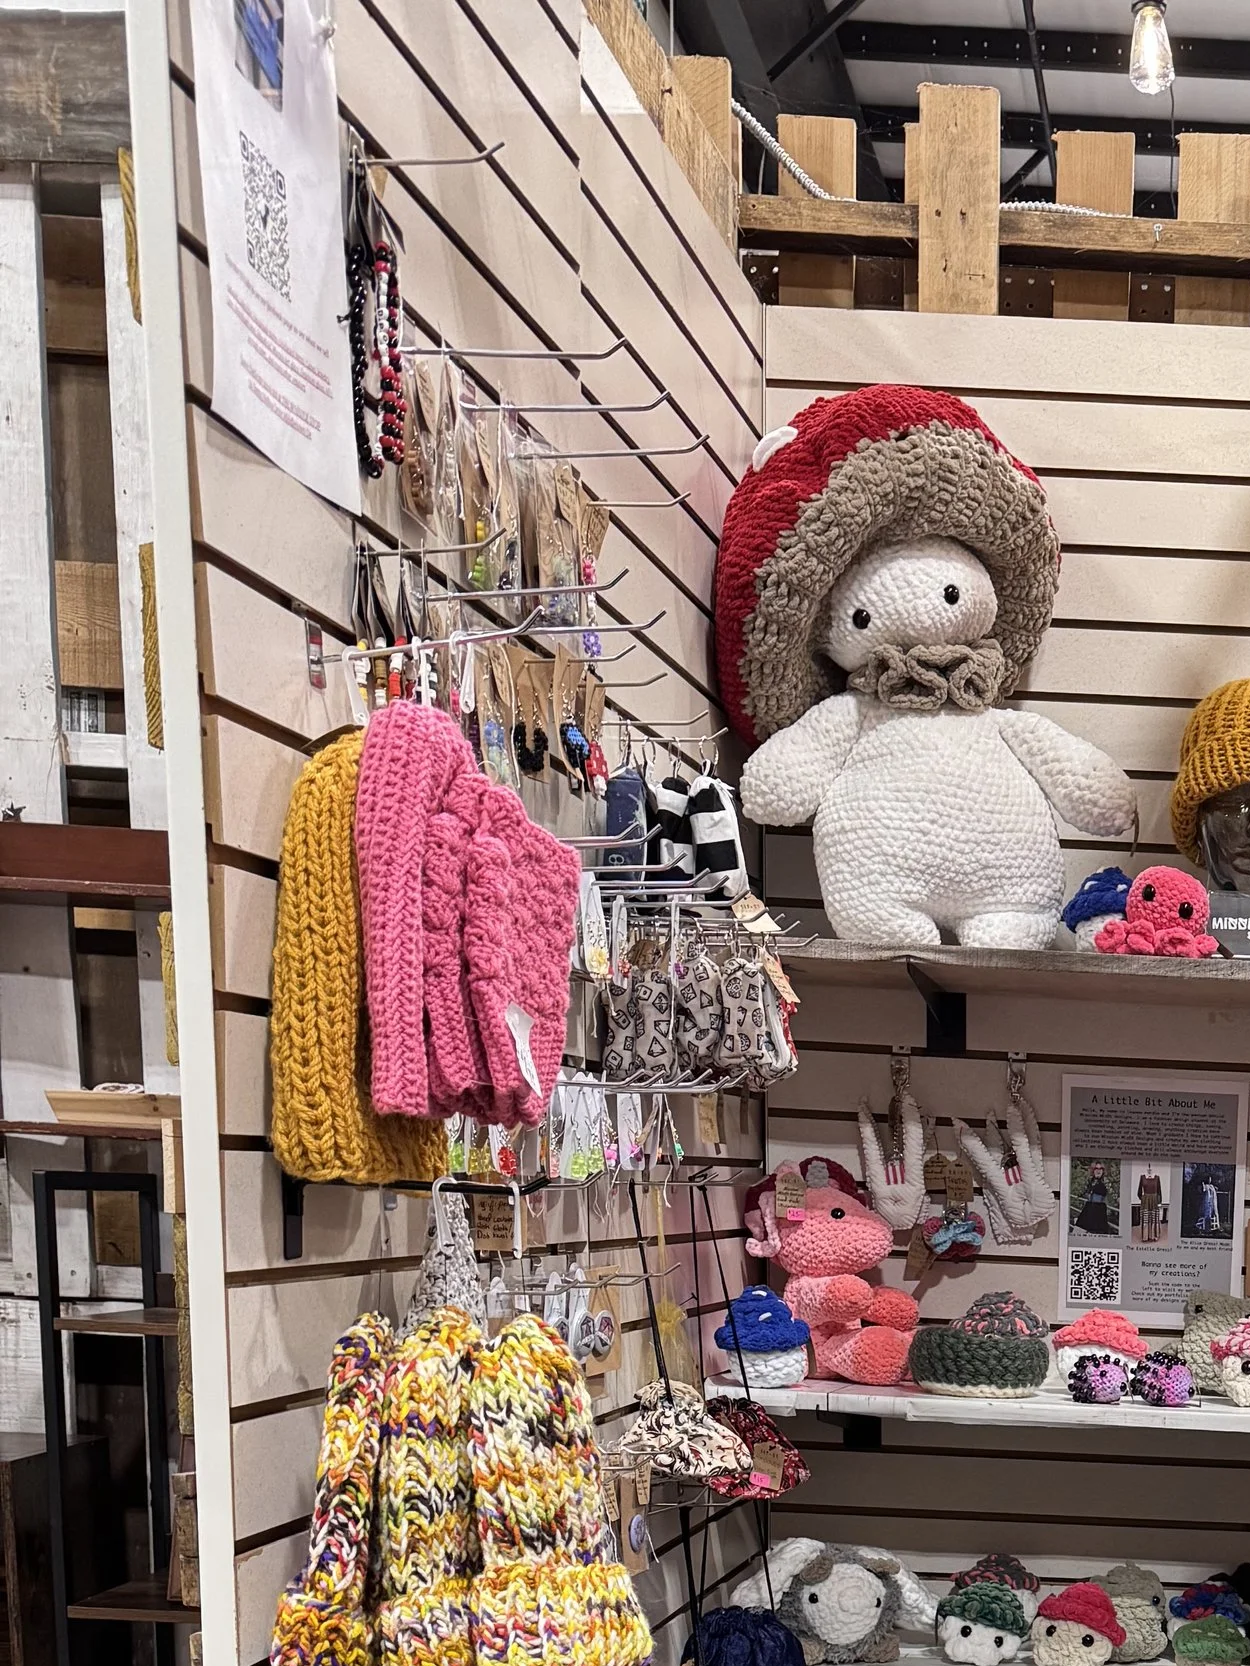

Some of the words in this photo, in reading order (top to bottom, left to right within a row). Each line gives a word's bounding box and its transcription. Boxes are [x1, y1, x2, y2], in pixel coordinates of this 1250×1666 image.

[1091, 1095, 1098, 1104] A
[1103, 1095, 1140, 1106] Little
[1145, 1097, 1163, 1107] Bit
[1168, 1099, 1198, 1109] About
[1204, 1100, 1216, 1110] Me
[1161, 1270, 1201, 1278] creations?
